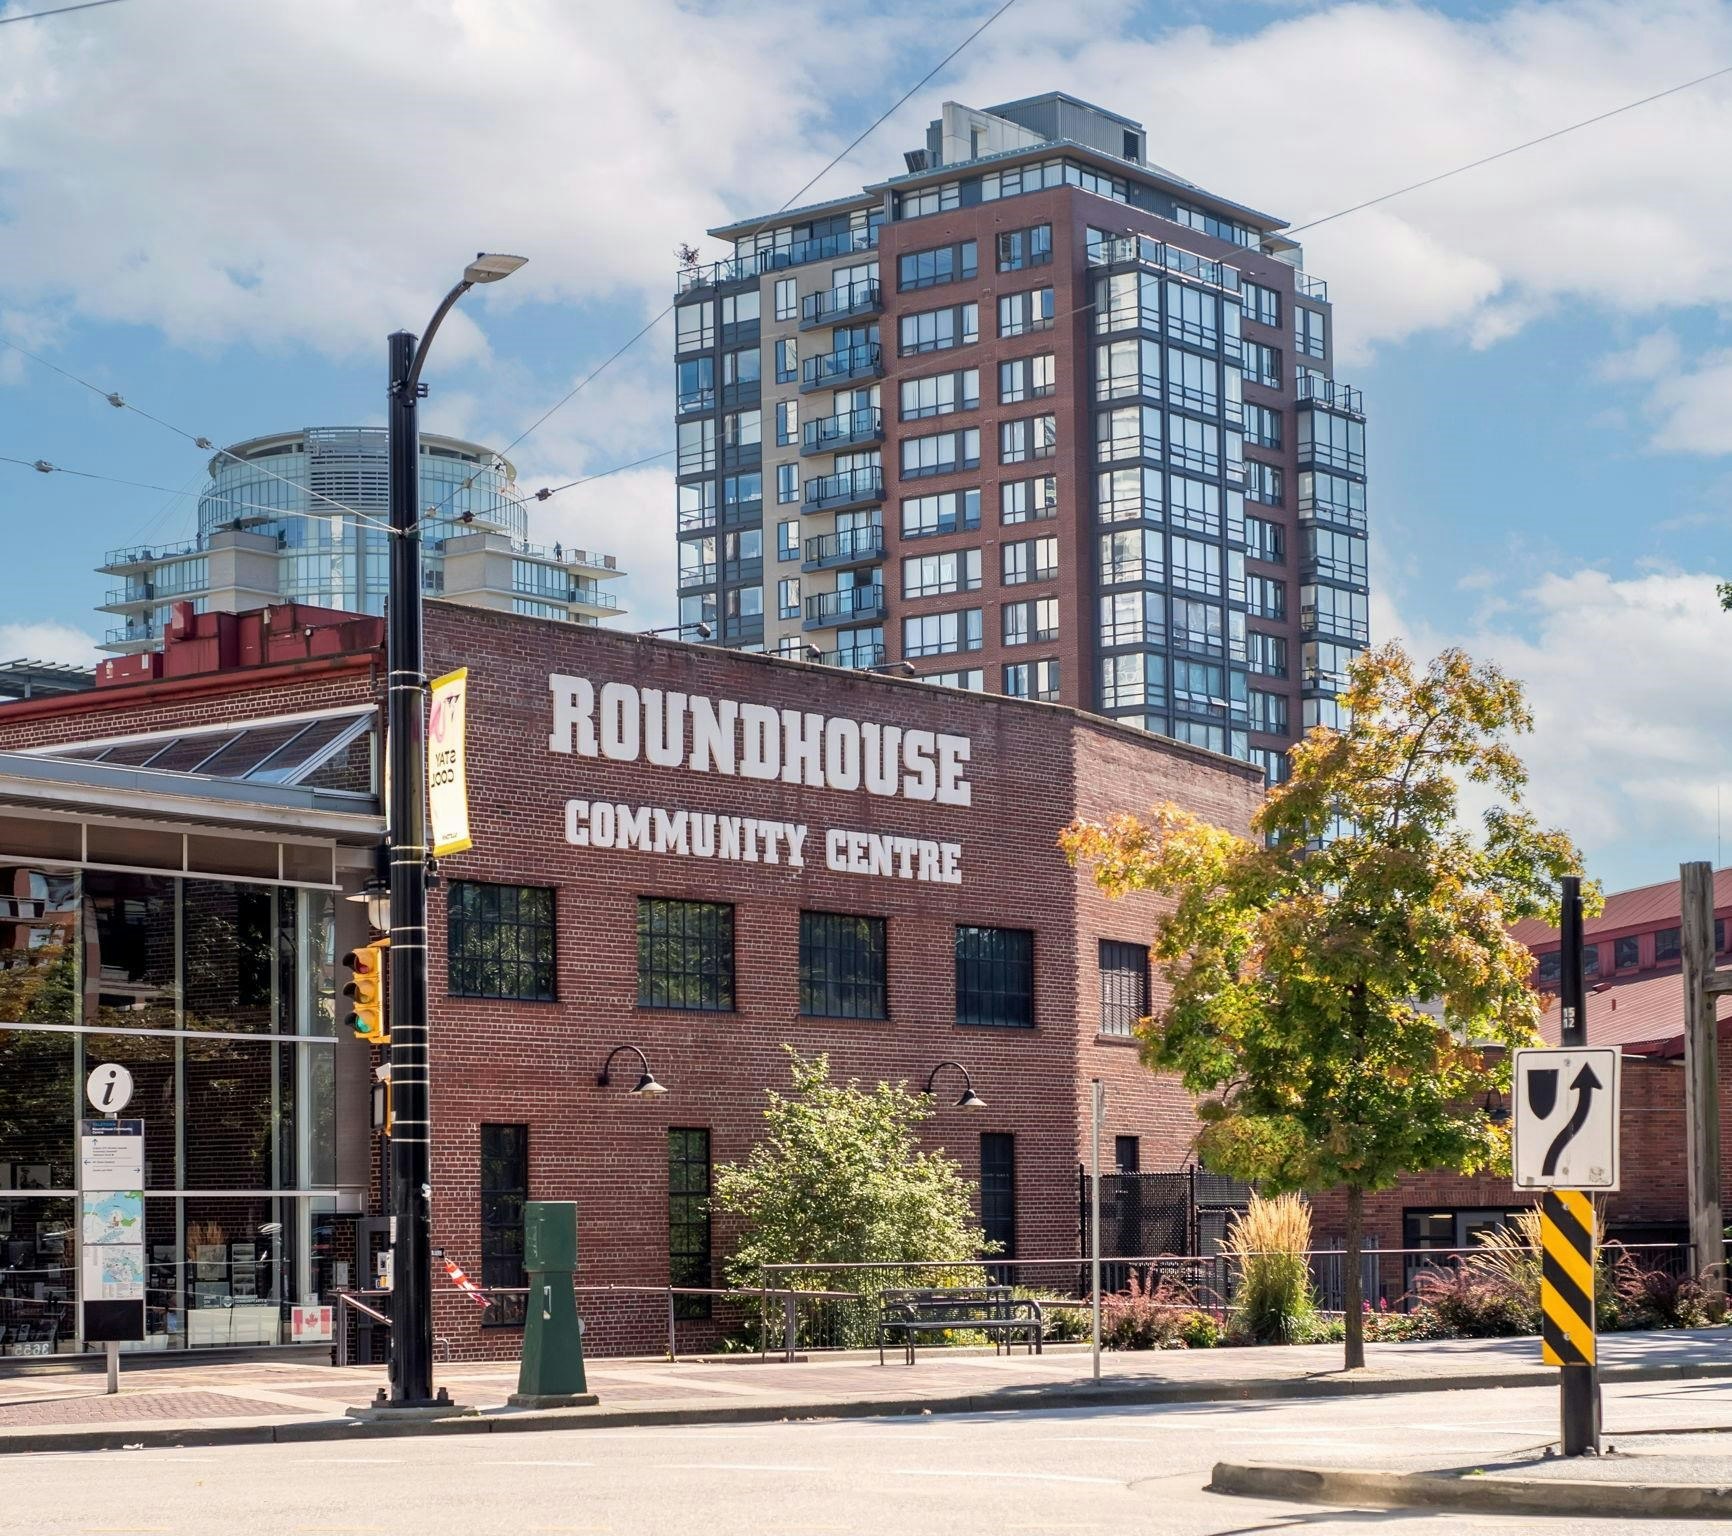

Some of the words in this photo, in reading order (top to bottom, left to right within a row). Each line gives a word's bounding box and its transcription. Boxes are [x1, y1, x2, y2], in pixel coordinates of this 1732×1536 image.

[549, 673, 971, 806] ROUNDHOUSE
[565, 799, 807, 866] COMMUNITY
[826, 828, 962, 884] CENTRE
[1563, 1007, 1575, 1018] 15
[1563, 1018, 1575, 1029] 12
